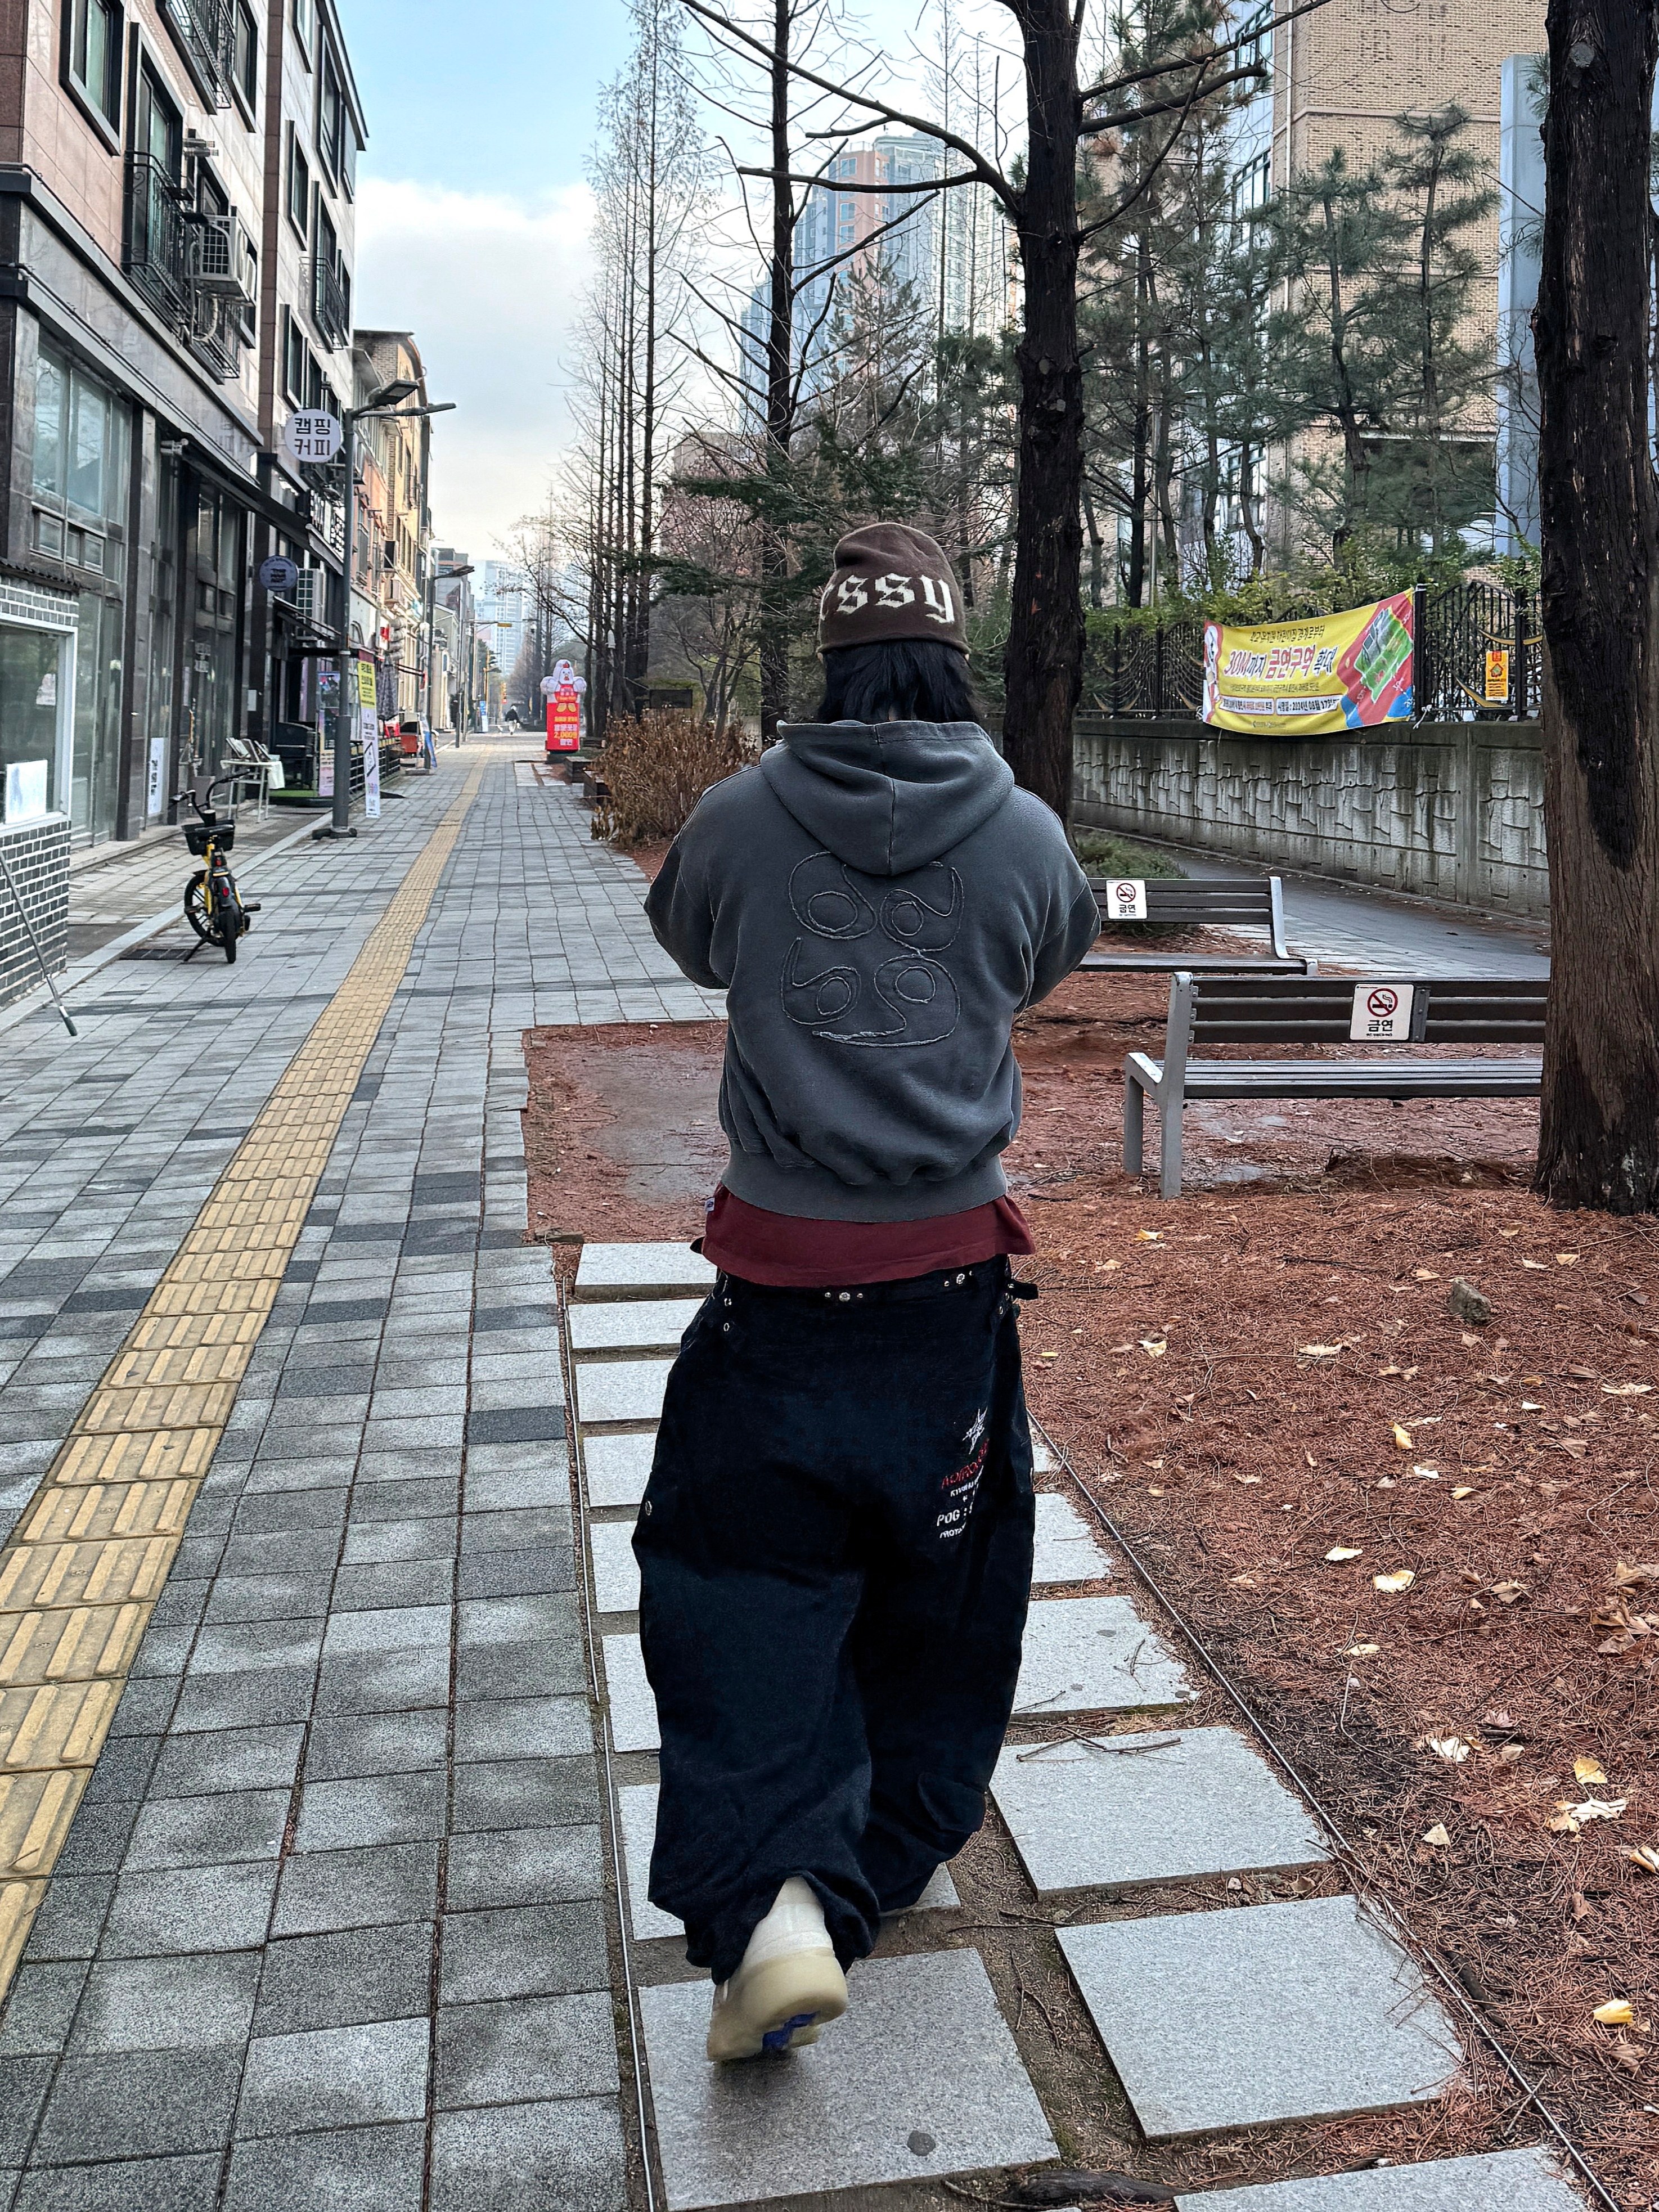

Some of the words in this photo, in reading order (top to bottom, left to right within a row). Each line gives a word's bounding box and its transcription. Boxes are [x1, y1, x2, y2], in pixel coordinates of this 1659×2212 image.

[294, 418, 330, 435] 캠핑
[294, 439, 330, 456] 커피
[1265, 645, 1316, 679] 금연구역
[1314, 646, 1338, 675] 확대
[1118, 904, 1136, 913] 금연
[1367, 1019, 1393, 1032] 금연
